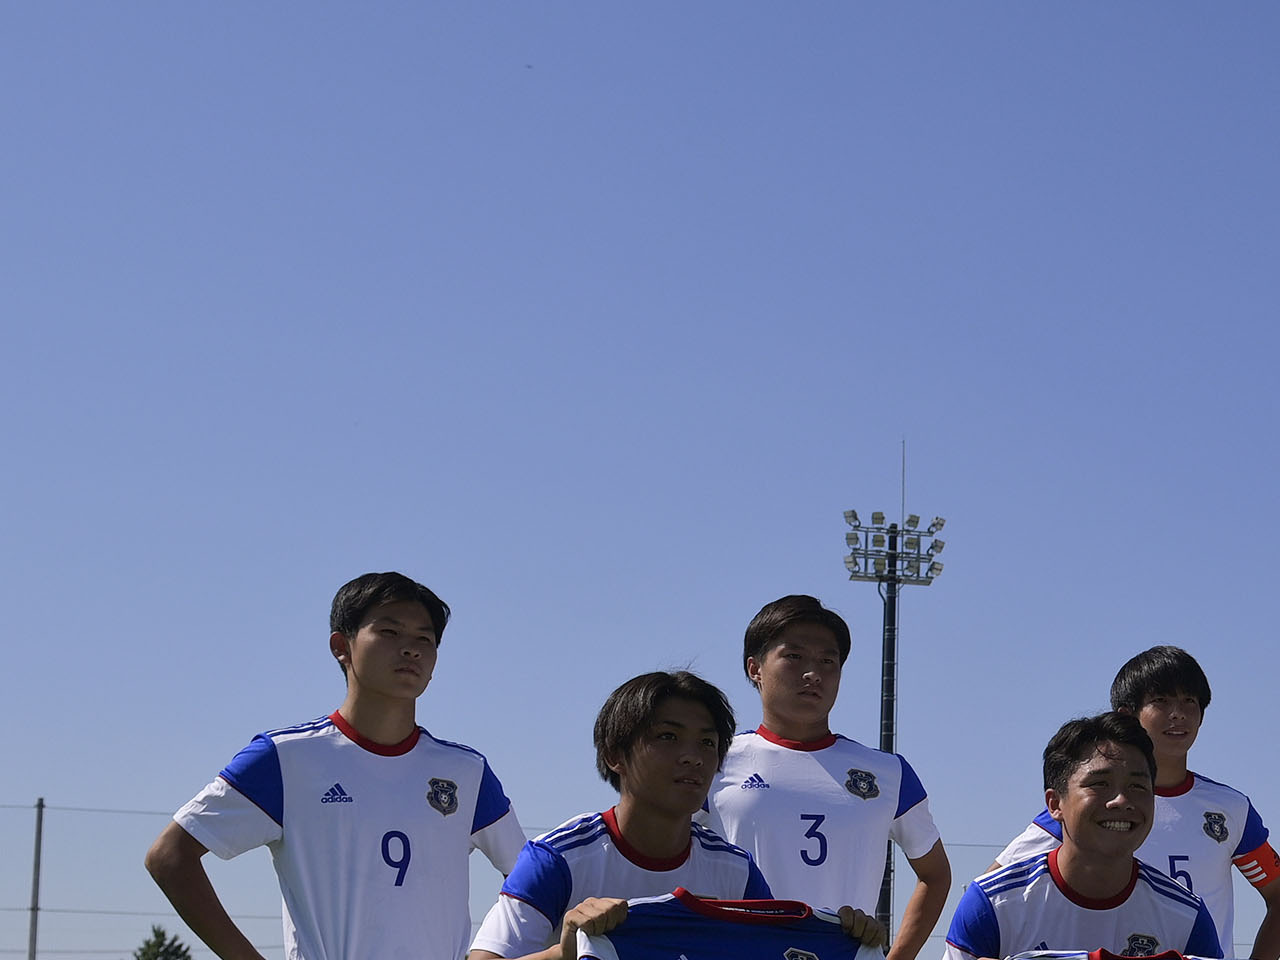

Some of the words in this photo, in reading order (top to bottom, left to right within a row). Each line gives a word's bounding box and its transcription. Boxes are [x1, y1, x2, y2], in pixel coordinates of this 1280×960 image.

[321, 795, 353, 804] adidas
[381, 830, 411, 886] 9
[800, 814, 828, 867] 3
[1168, 855, 1193, 893] 5
